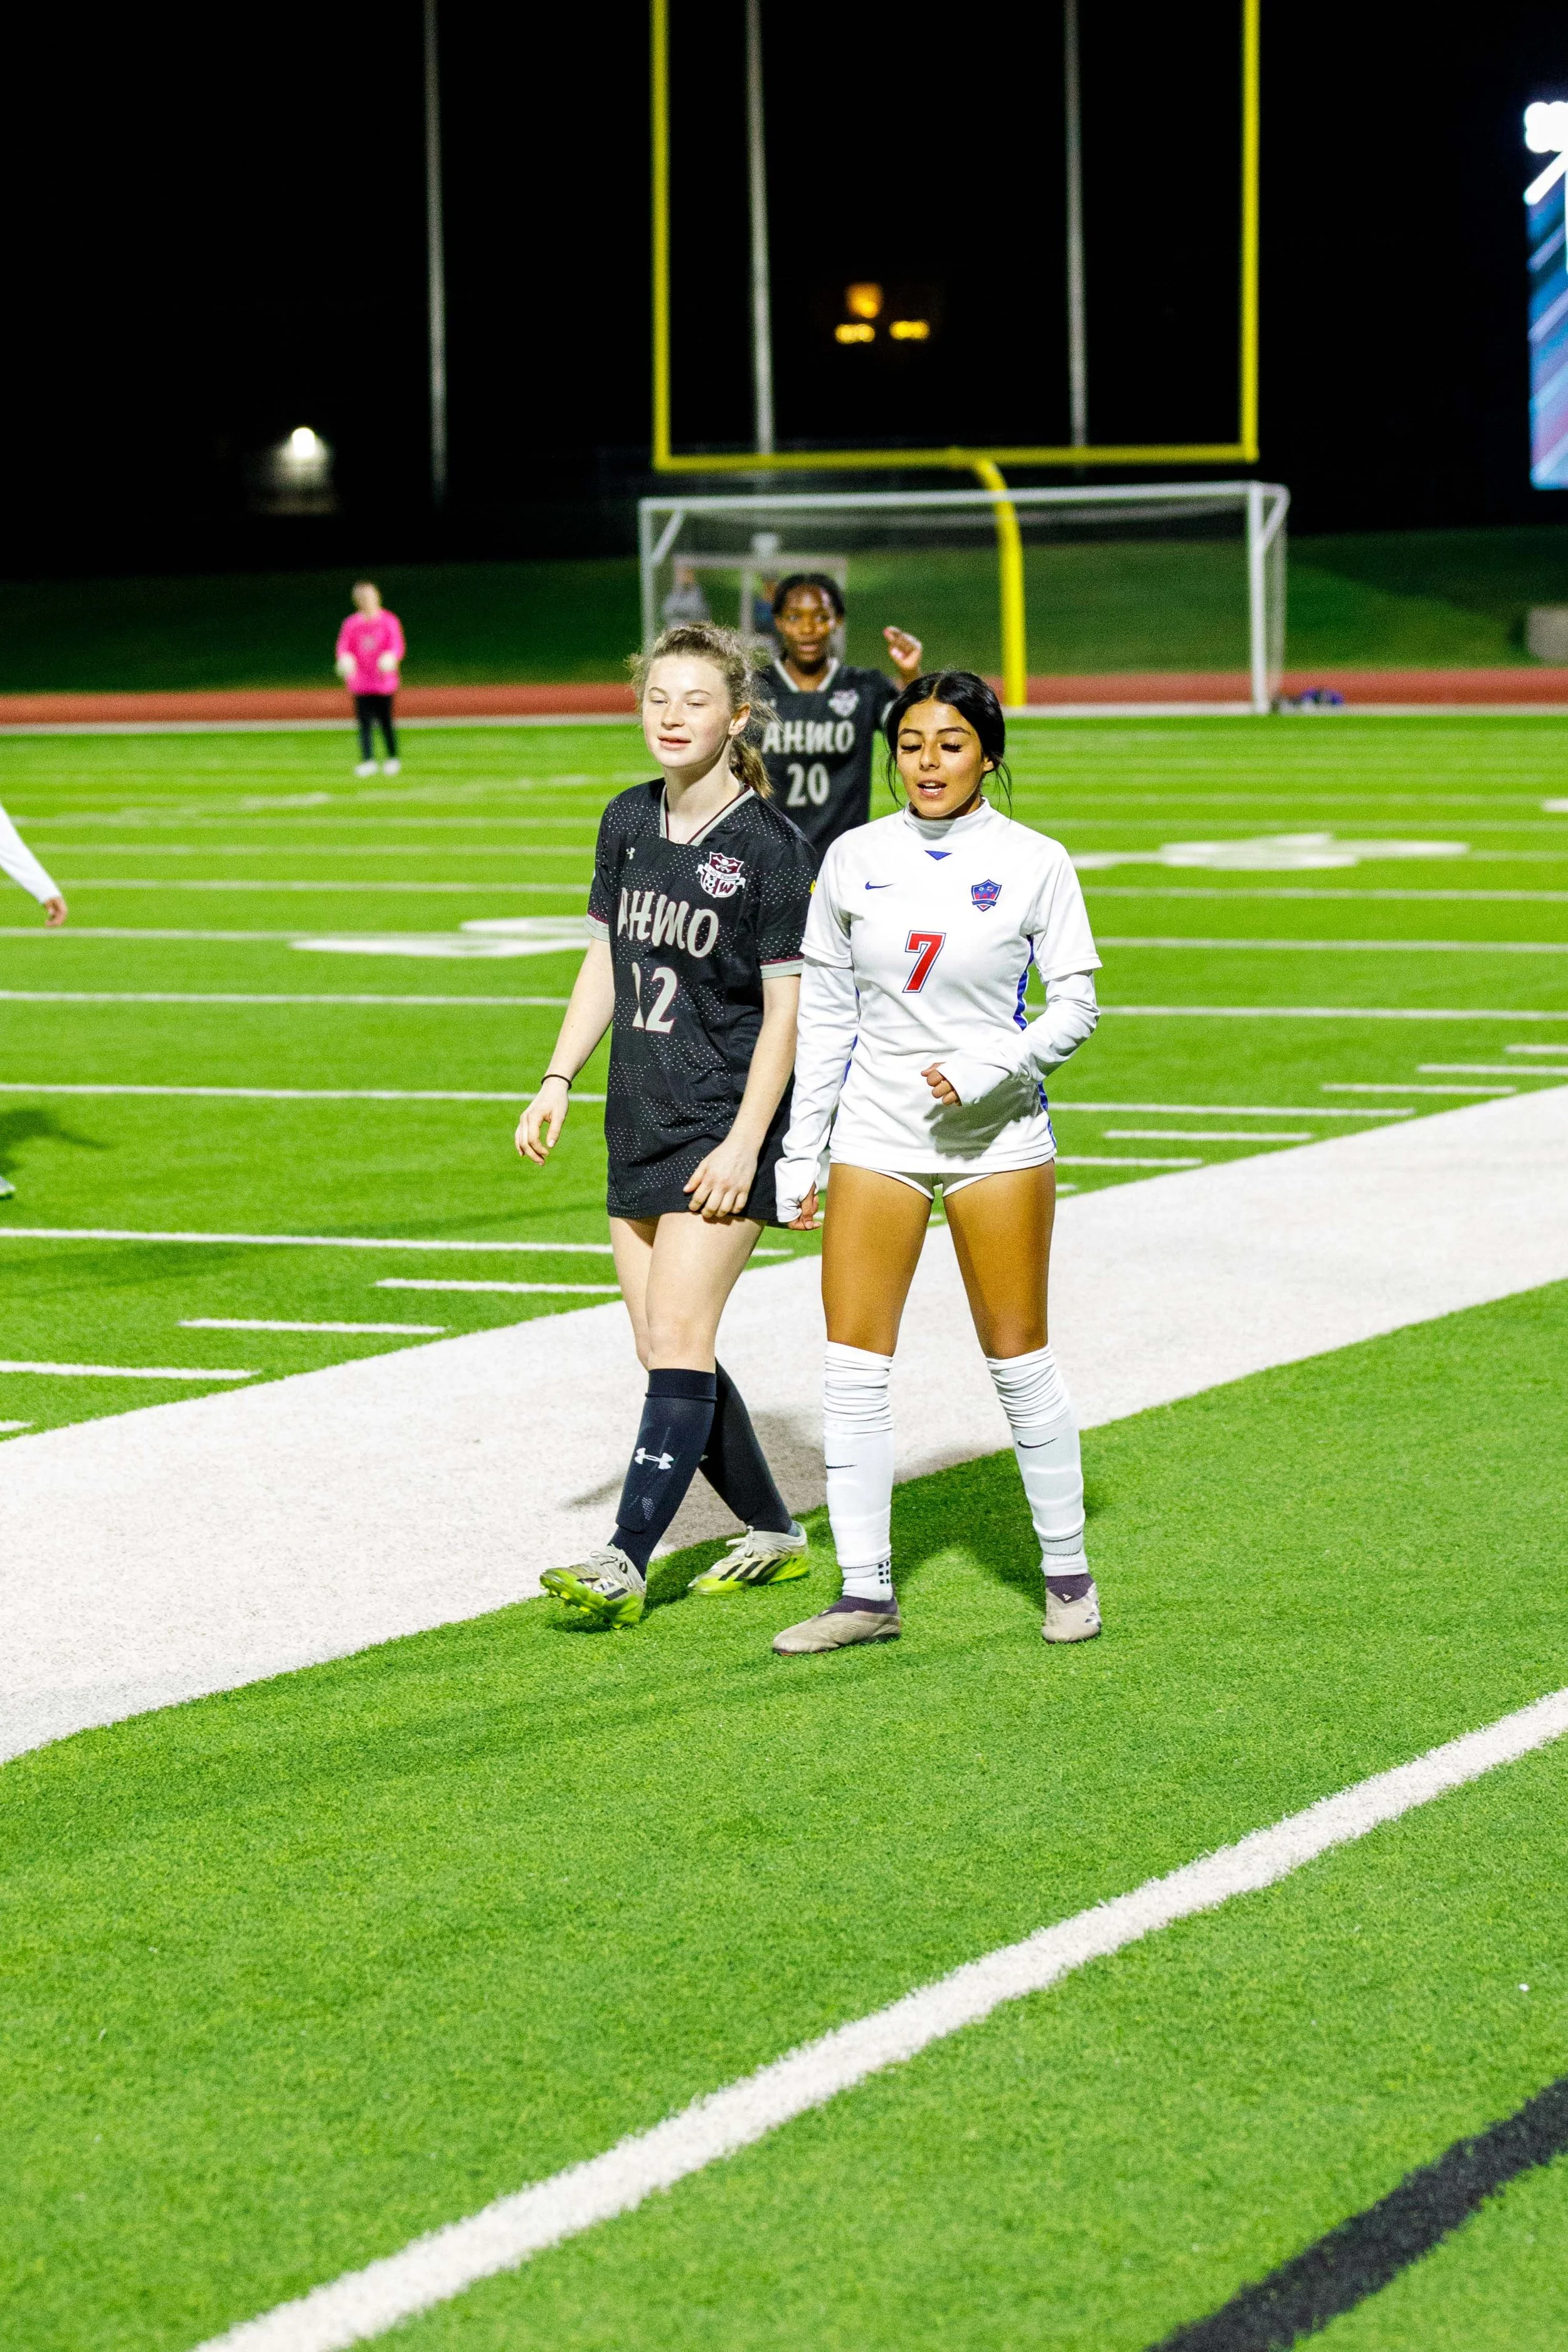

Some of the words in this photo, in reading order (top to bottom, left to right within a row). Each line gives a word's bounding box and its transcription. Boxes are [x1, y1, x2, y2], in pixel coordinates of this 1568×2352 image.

[762, 720, 855, 753] AHMO
[786, 762, 830, 807] 20
[719, 882, 734, 894] W
[617, 887, 719, 958] AHMO
[903, 930, 946, 993] 7
[632, 961, 677, 1033] 12
